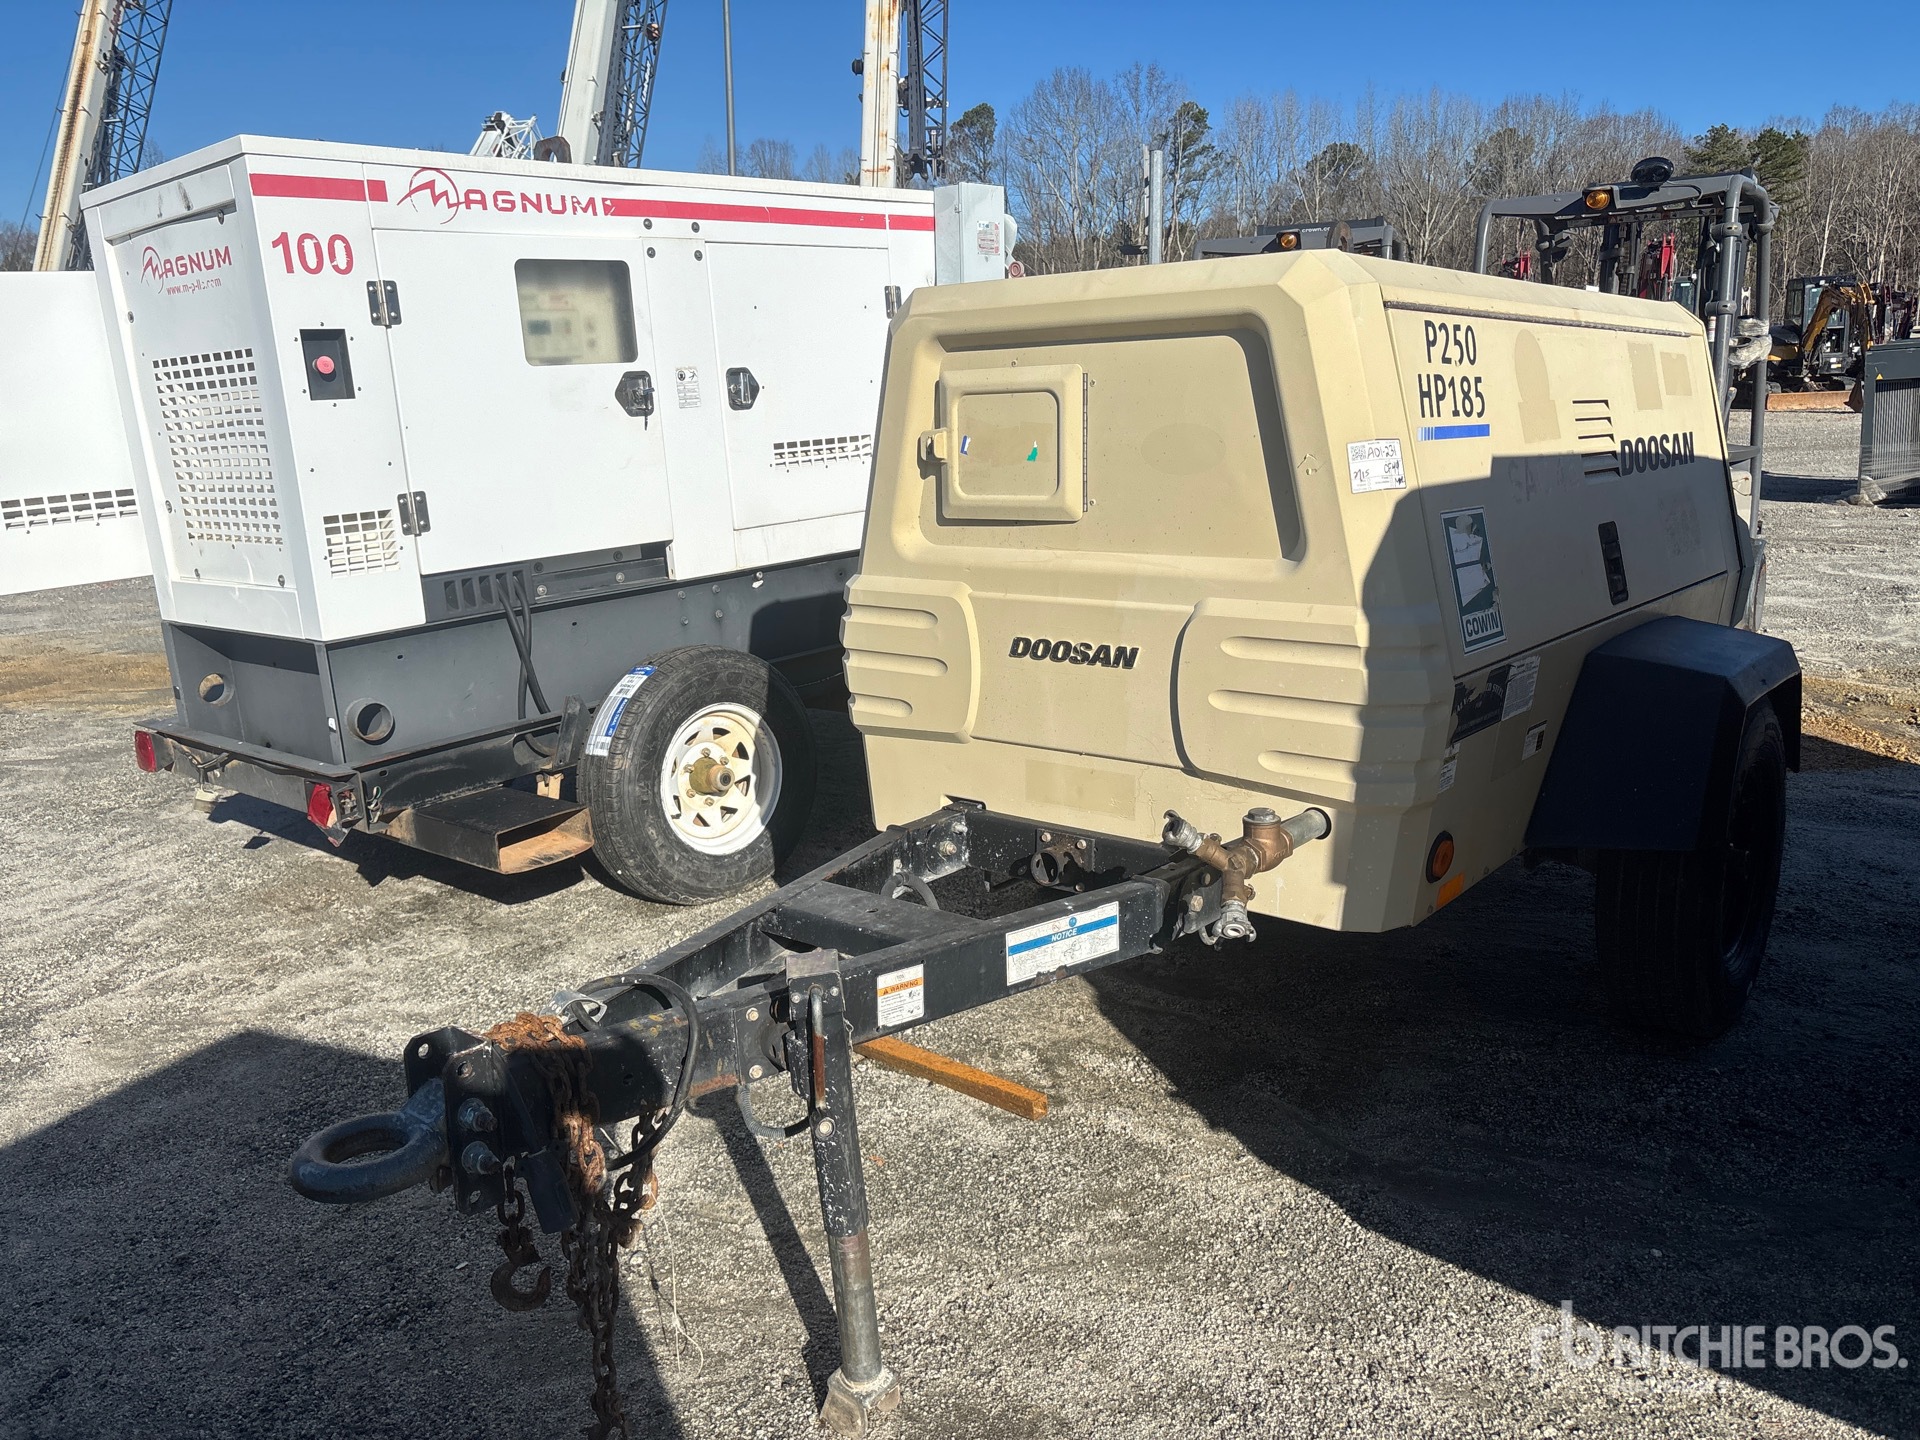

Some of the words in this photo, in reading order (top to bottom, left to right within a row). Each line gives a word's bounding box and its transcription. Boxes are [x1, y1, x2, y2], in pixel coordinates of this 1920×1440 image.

[397, 177, 598, 217] MAGNUM
[141, 245, 232, 283] MAGNUM
[271, 232, 354, 275] 100
[1424, 319, 1477, 366] P250
[1417, 373, 1485, 418] HP185
[1620, 431, 1695, 477] DOOSAN
[1465, 611, 1499, 637] COWIN
[1008, 636, 1140, 669] DOOSAN
[1051, 928, 1078, 942] NOTICE
[890, 979, 919, 993] WARNING
